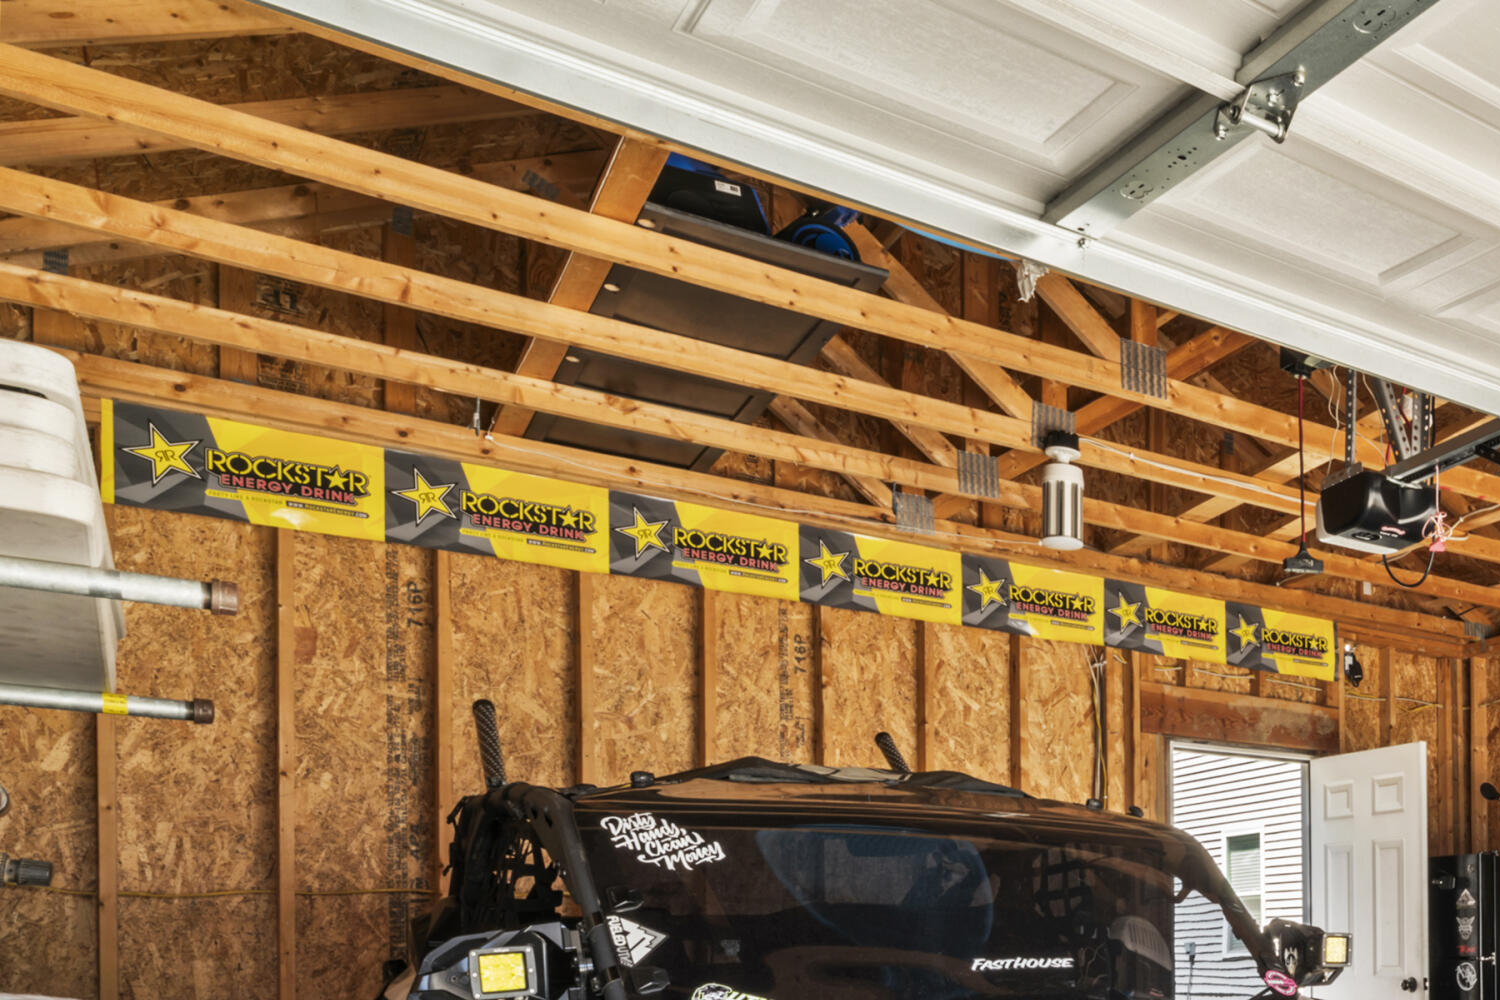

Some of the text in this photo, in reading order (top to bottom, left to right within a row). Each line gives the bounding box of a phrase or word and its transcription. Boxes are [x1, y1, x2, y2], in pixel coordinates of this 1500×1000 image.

[207, 450, 369, 495] ROCKSTAR
[221, 474, 355, 503] ENERGY DRINK
[461, 491, 596, 532] ROCKSTAR
[473, 514, 532, 531] ENERGY
[539, 526, 586, 541] DRINK
[674, 528, 788, 562] ROCKSTAR
[683, 548, 734, 564] ENERGY
[740, 558, 778, 571] DRINK
[862, 577, 906, 592] ENERGY
[910, 585, 944, 597] DRINK
[1016, 602, 1054, 615] ENERGY
[1058, 609, 1087, 620] DRINK
[637, 841, 726, 871] Money
[606, 915, 627, 947] FUELED
[971, 956, 1074, 971] FASTHOUSE
